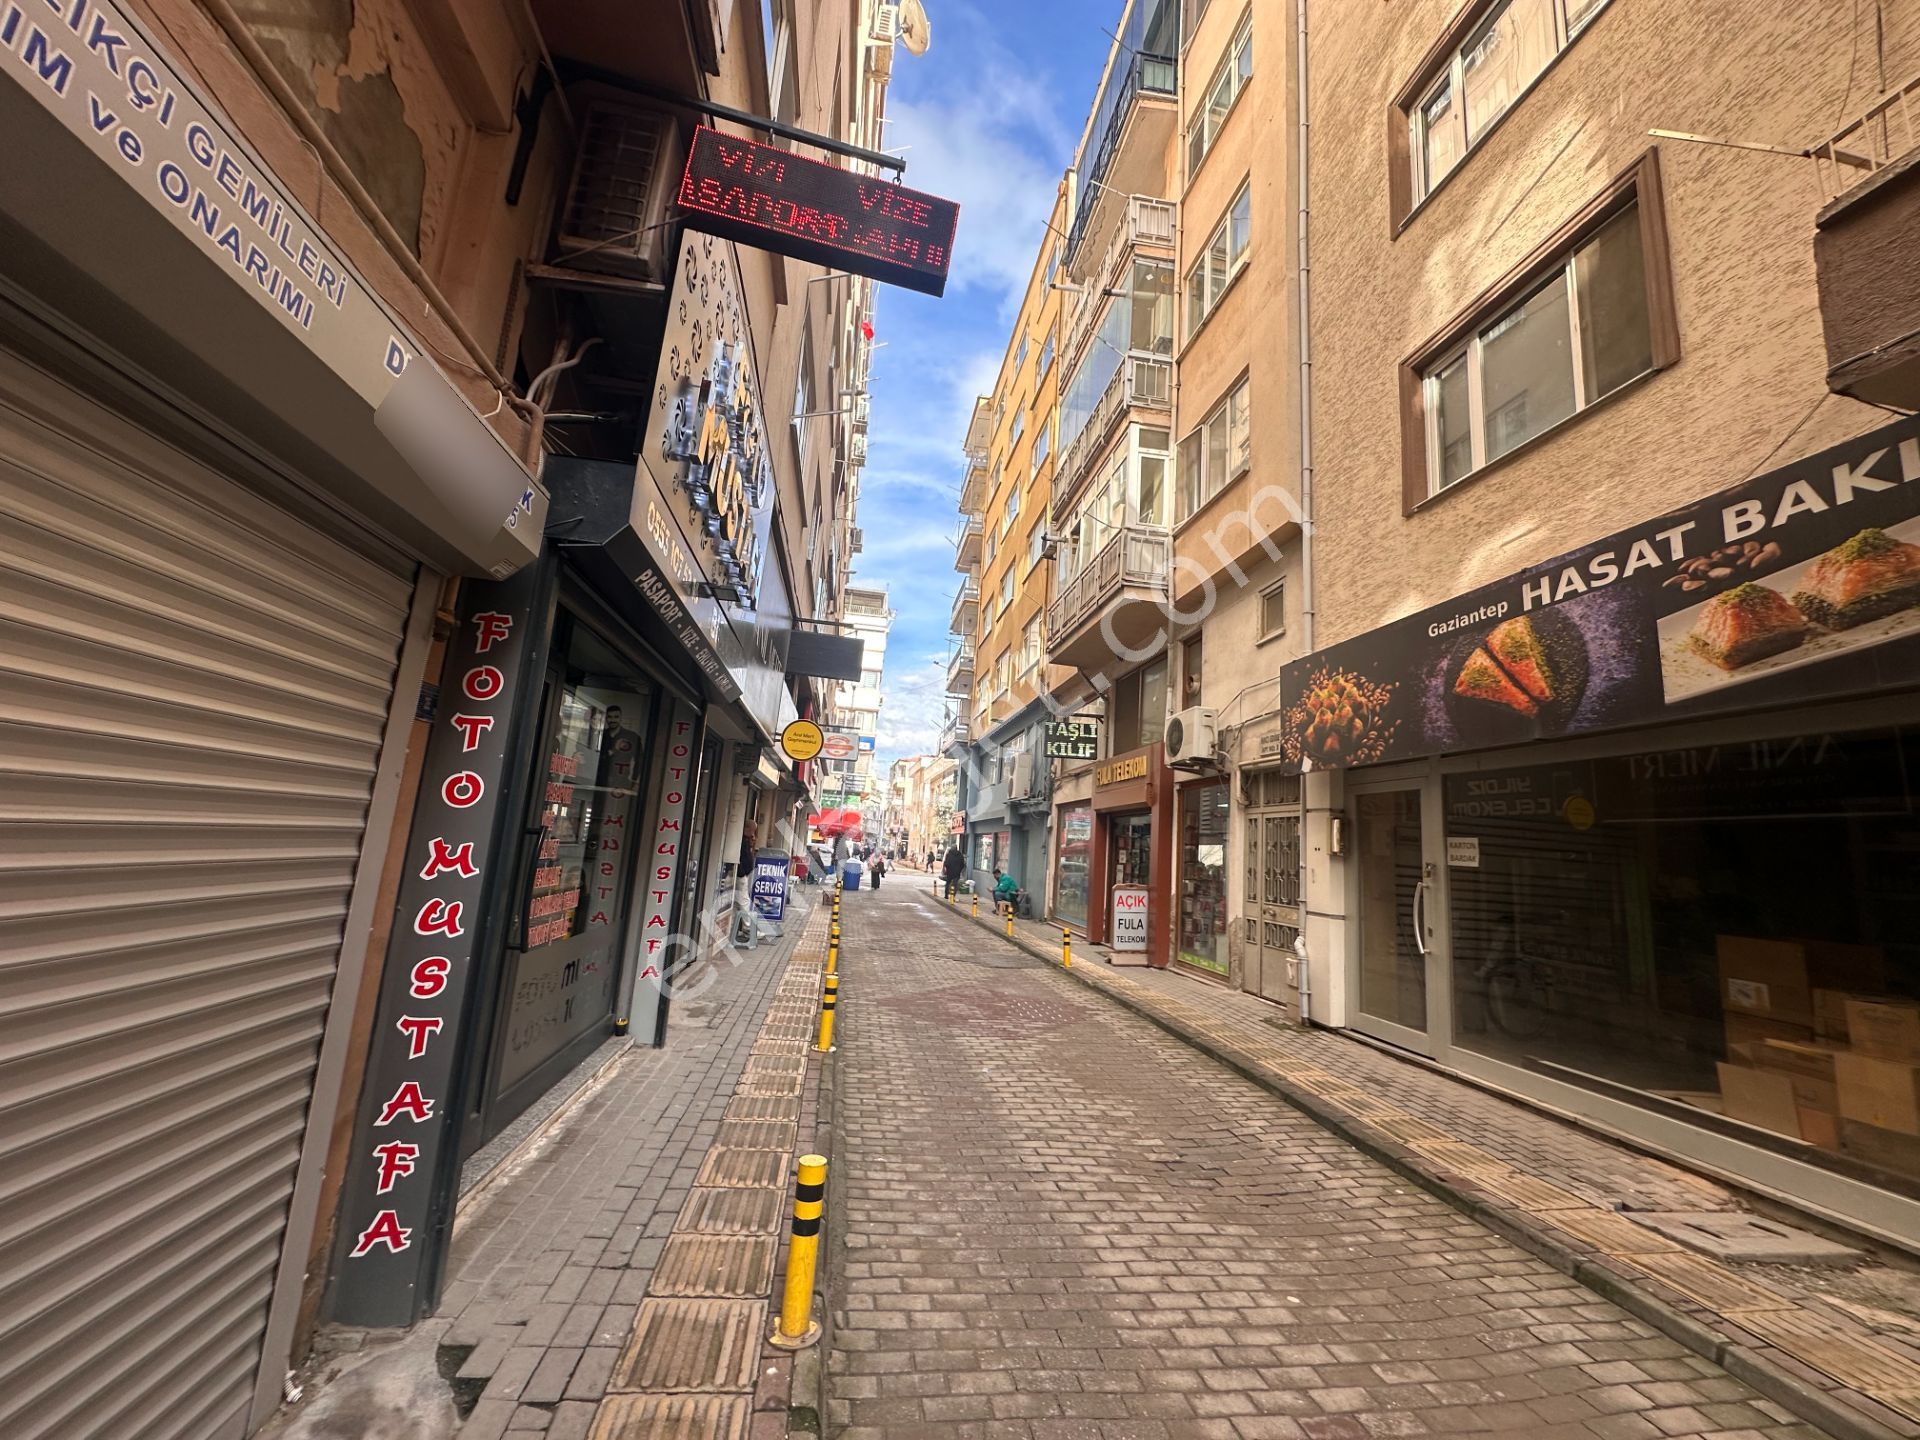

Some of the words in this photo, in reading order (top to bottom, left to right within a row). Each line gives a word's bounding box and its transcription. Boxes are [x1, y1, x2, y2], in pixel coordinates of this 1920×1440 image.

[90, 94, 143, 164] ve
[158, 161, 315, 330] ONARIMI
[186, 122, 349, 309] GEMİLERİ
[634, 568, 684, 625] PASAPORT
[1428, 600, 1509, 638] Gaziantep
[1521, 520, 1696, 612] HASAT
[441, 611, 514, 809] FOTO
[1045, 721, 1097, 740] TAŞLI
[666, 721, 690, 805] FOTO
[1046, 741, 1096, 757] KILIF
[1113, 755, 1147, 783] TELEKOM
[754, 879, 784, 895] SERVİS
[757, 862, 788, 878] TEKNİK
[639, 818, 681, 980] MUSTAFA
[1116, 895, 1146, 909] AÇIK
[1116, 935, 1146, 944] TELEKOM
[1118, 918, 1144, 930] FULA
[348, 836, 481, 1258] MUSTAFA
